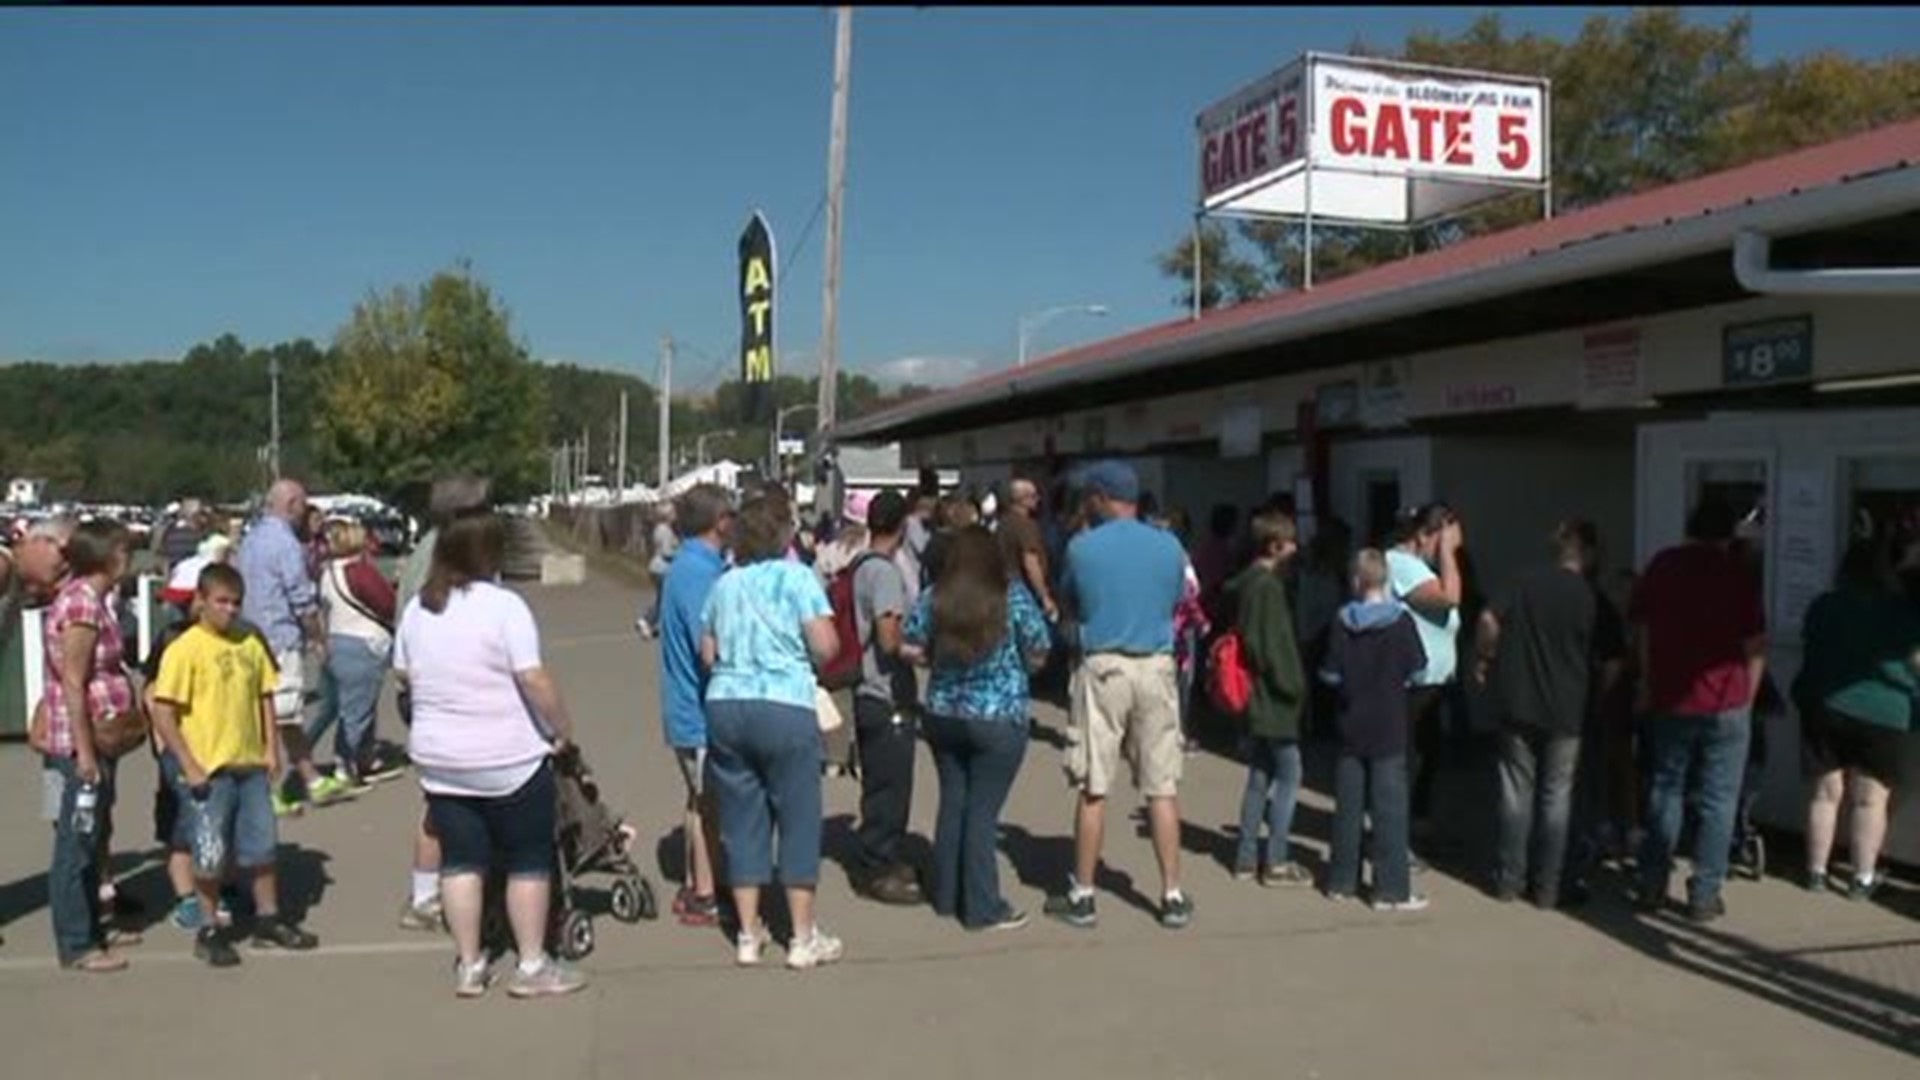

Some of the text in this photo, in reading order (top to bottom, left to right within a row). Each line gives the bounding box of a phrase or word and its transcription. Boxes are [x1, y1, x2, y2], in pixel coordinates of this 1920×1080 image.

[1329, 97, 1531, 171] GATE 5
[1503, 94, 1533, 108] FAIR
[1202, 97, 1297, 192] GATE 5
[745, 257, 771, 384] ATM
